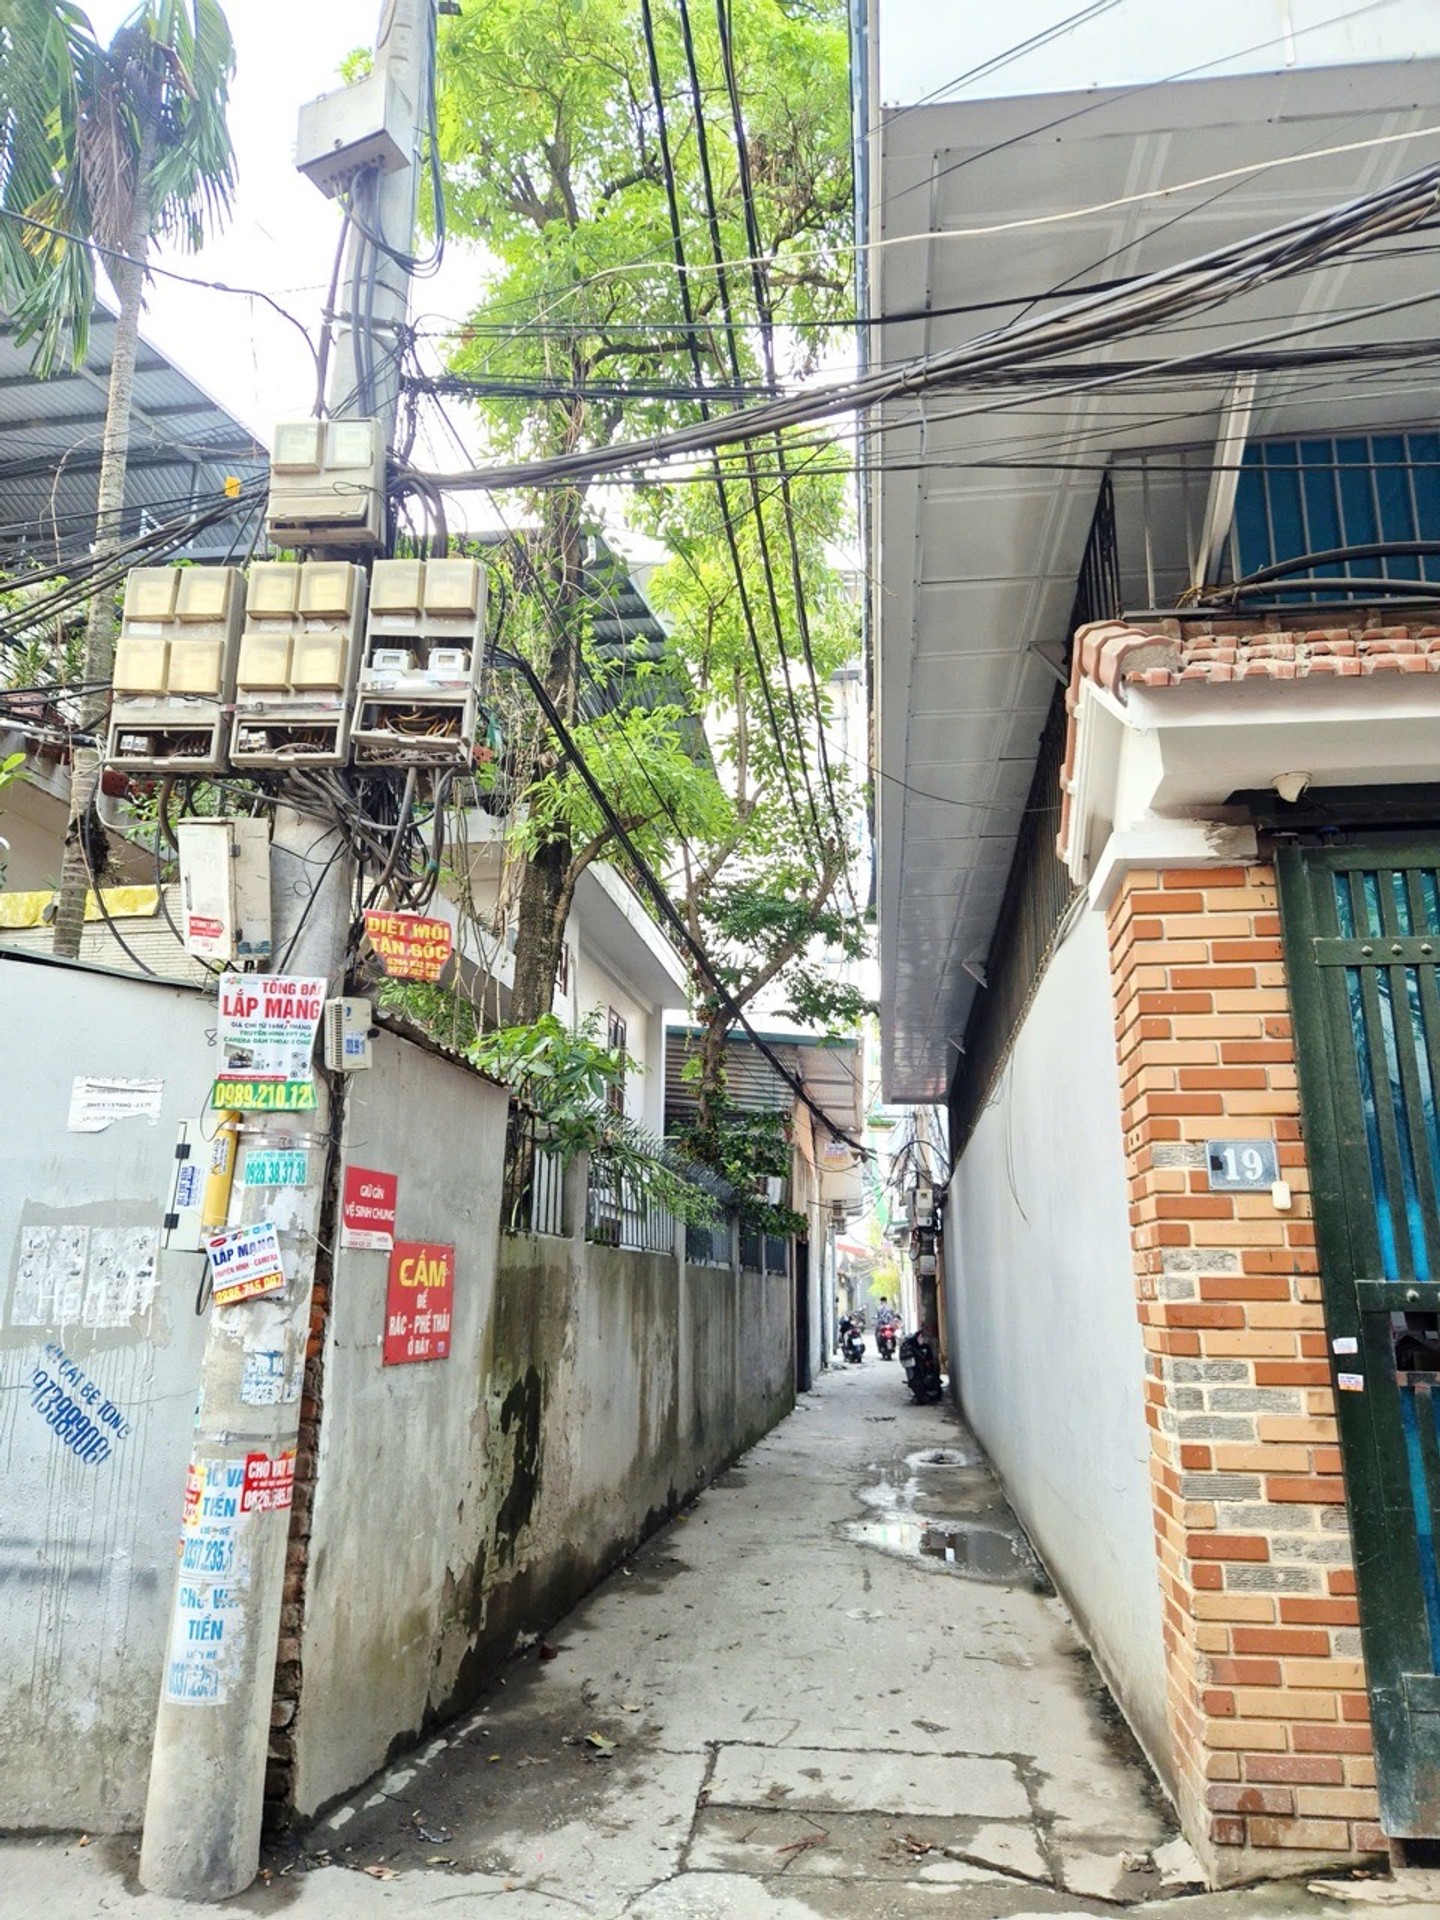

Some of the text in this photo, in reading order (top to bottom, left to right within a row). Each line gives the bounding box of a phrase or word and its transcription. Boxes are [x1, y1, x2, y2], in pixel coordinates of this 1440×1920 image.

[223, 988, 321, 1024] LẮP MẠNG
[1223, 1148, 1263, 1180] 19
[399, 1249, 447, 1287] CẤM
[248, 1461, 270, 1478] CHO
[188, 1613, 224, 1641] TIỀN
